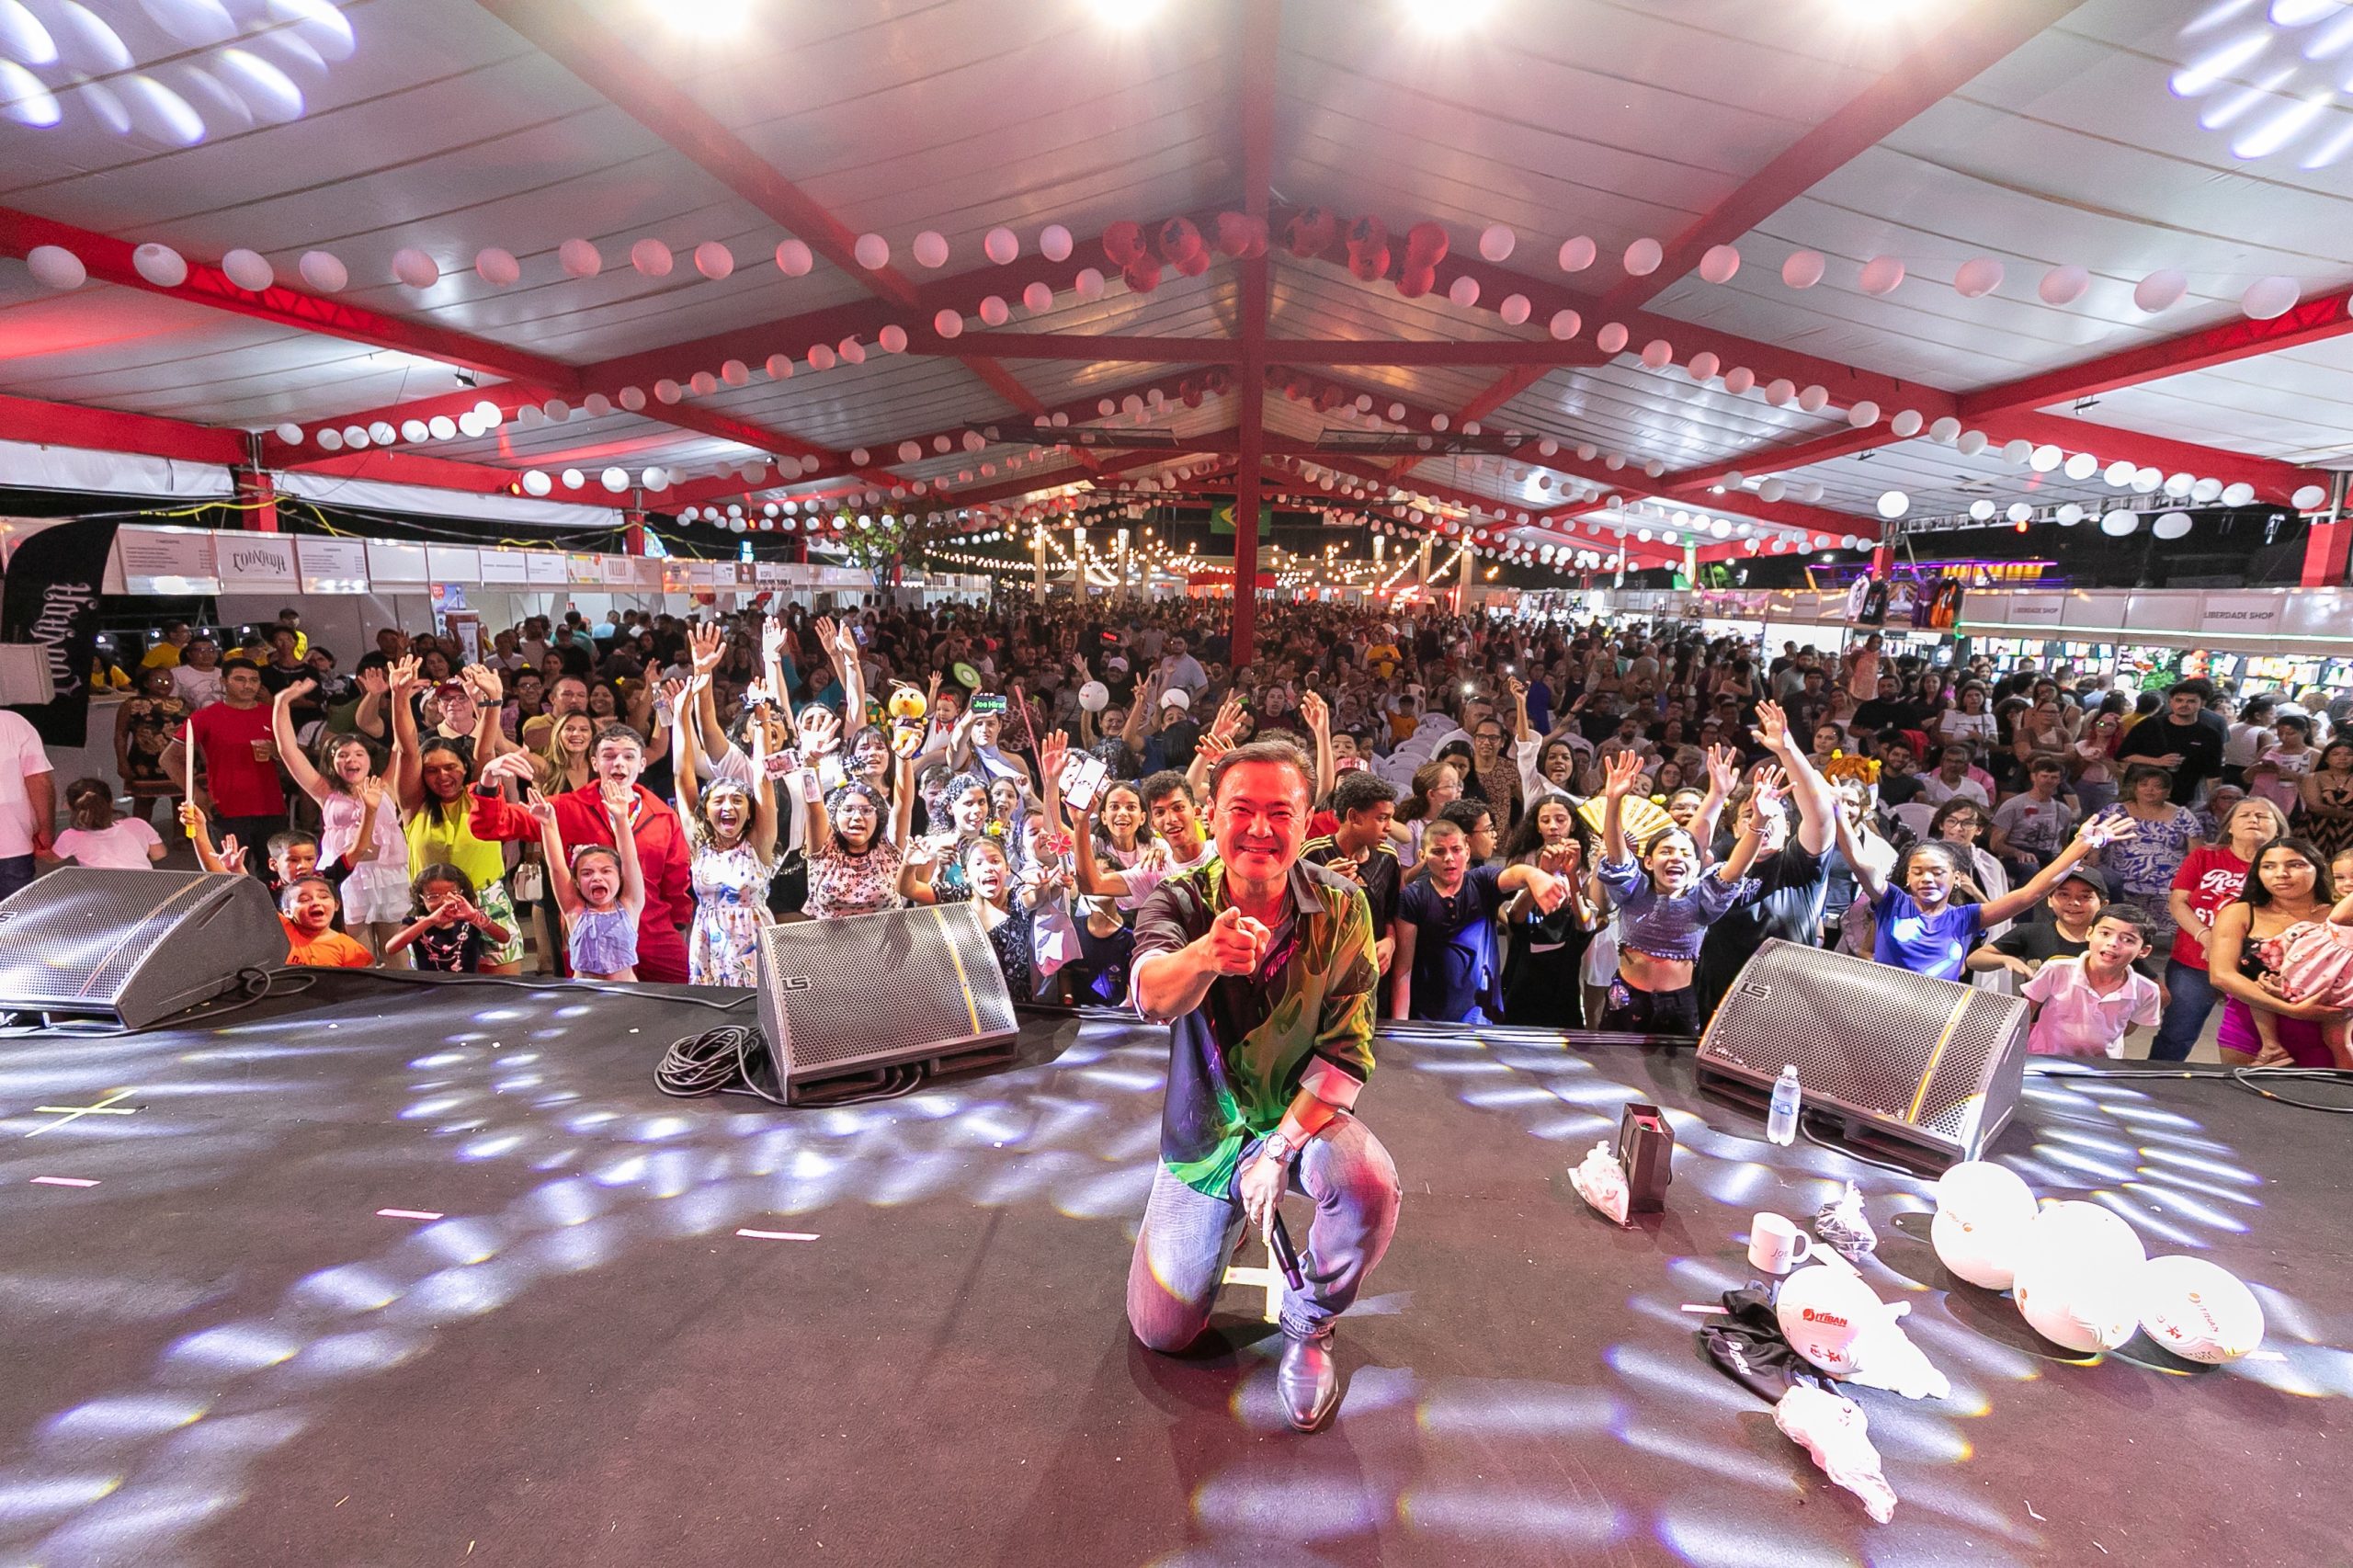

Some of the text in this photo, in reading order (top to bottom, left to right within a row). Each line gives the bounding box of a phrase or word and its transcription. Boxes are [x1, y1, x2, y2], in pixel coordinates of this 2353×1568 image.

[2203, 611, 2274, 619] LIBERDADE SHOP
[1815, 1312, 1847, 1325] ITIBAN
